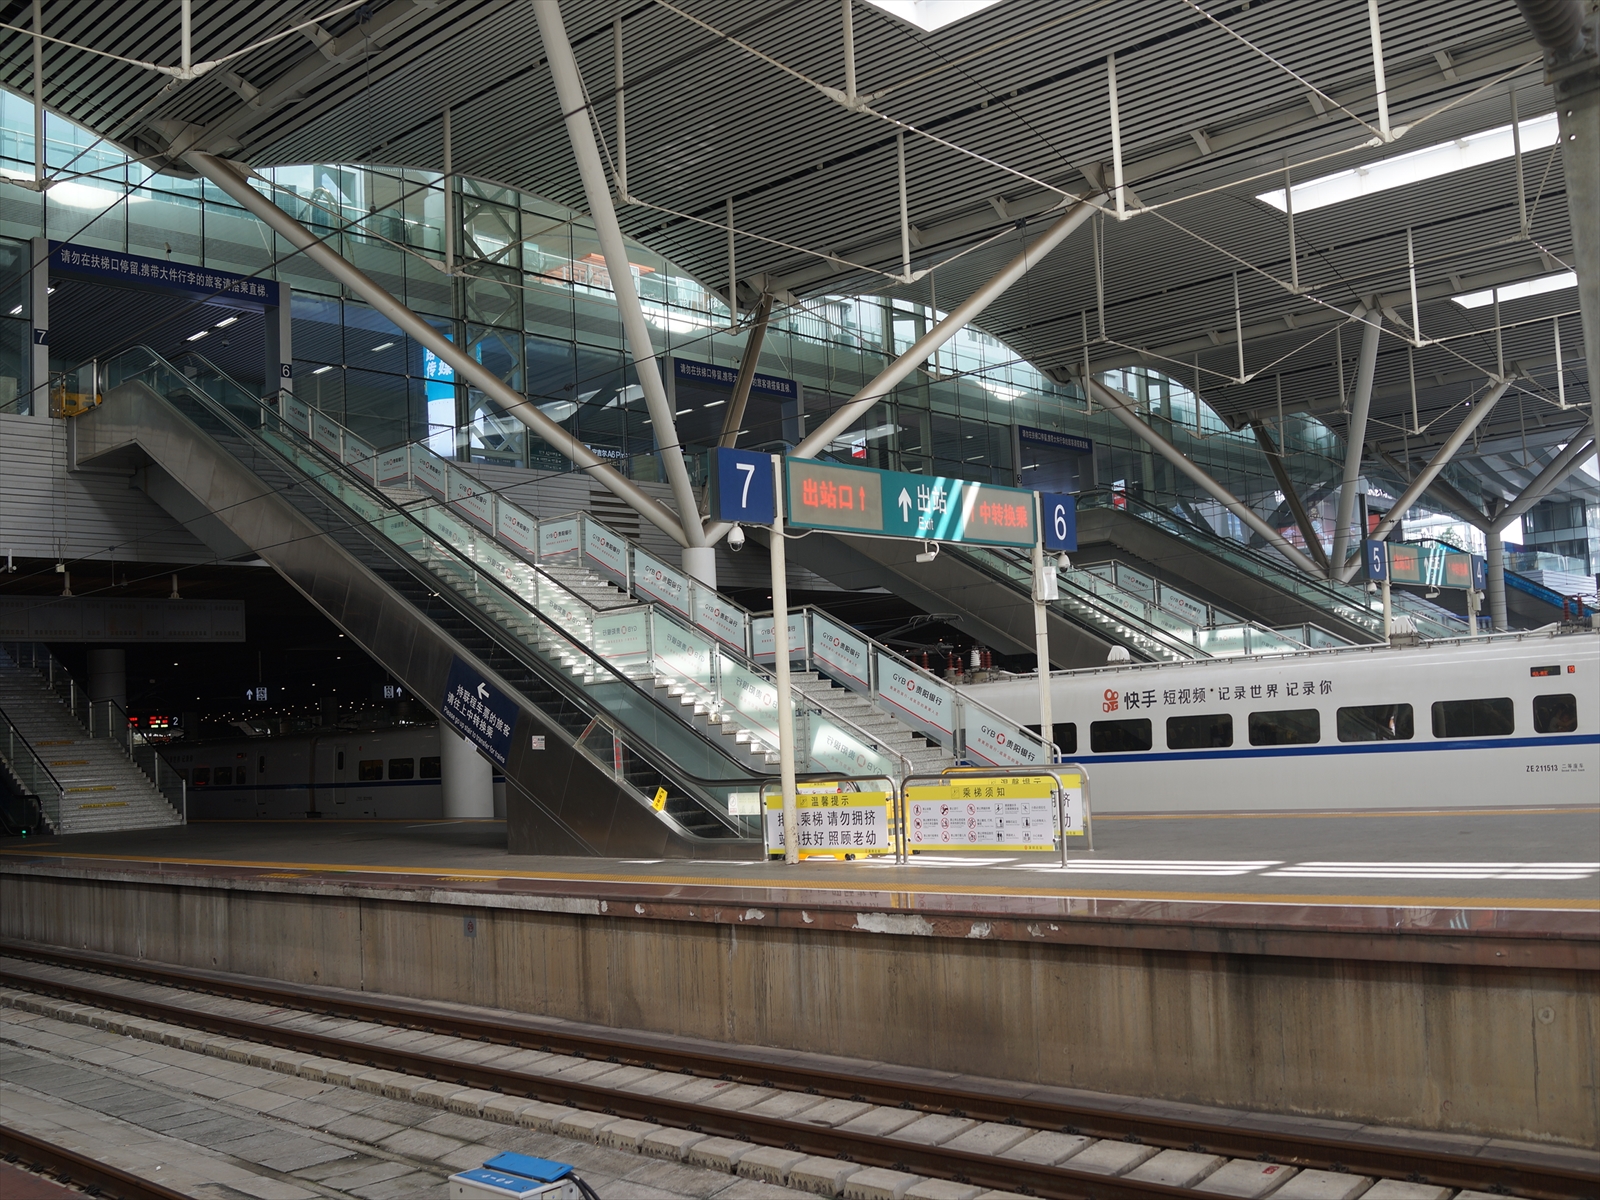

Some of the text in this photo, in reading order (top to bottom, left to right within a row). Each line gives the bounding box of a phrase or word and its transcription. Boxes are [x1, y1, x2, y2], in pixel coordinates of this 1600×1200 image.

[36, 330, 47, 344] 7
[282, 365, 290, 377] 6
[736, 463, 755, 508] 7
[803, 478, 853, 510] 出站口
[917, 484, 947, 515] 出站
[918, 517, 934, 531] Exit
[979, 500, 1028, 528] 中转换乘
[1054, 504, 1067, 541] 6
[592, 533, 600, 543] GYB
[1373, 547, 1380, 572] 5
[1477, 561, 1482, 583] 4
[645, 565, 655, 576] GYB
[662, 575, 682, 592] 贵阳银行
[705, 603, 738, 628] GYB 贵阳银行
[823, 632, 861, 659] GYB 贵阳银行
[892, 673, 943, 706] GYB 贵阳银行
[1124, 689, 1158, 710] 快手
[1285, 680, 1334, 698] 记录你
[172, 716, 179, 726] 2
[447, 691, 494, 739] 请往上中转换乘
[456, 684, 511, 738] 持联程车票的旅客
[443, 705, 456, 721] Please
[455, 717, 460, 725] go
[471, 731, 477, 739] to
[475, 734, 490, 749] transfer
[494, 750, 506, 764] trains
[981, 725, 1036, 761] GYB 贵阳银行
[1535, 764, 1558, 772] 211513
[811, 795, 849, 807] 温馨提示
[963, 786, 1005, 798] 乘梯须知
[827, 809, 876, 827] 请勿拥挤
[828, 830, 877, 847] 照顾老幼
